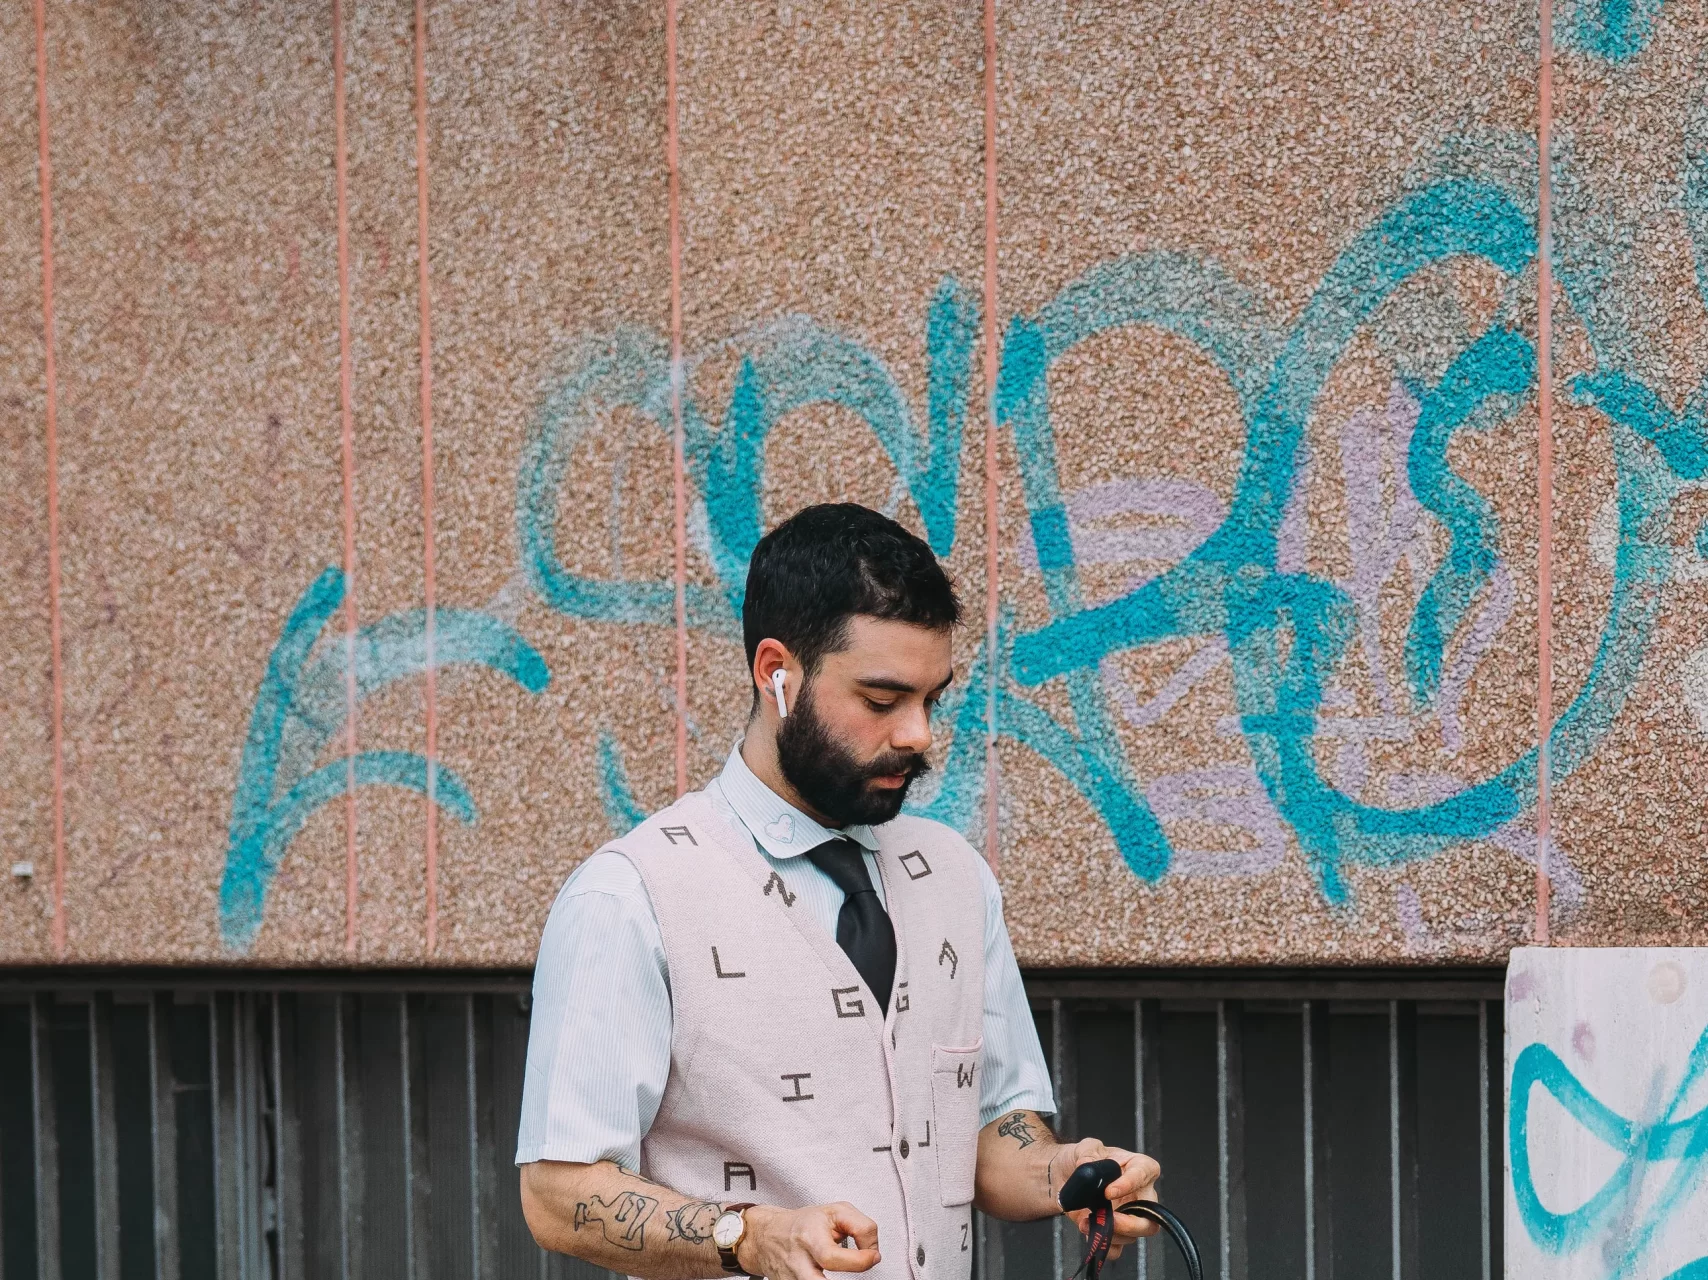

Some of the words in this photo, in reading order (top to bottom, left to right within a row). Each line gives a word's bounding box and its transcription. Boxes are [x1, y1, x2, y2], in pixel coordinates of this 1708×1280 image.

[711, 946, 746, 979] L
[831, 986, 865, 1018] G
[780, 1073, 814, 1102] I
[723, 1161, 757, 1191] A
